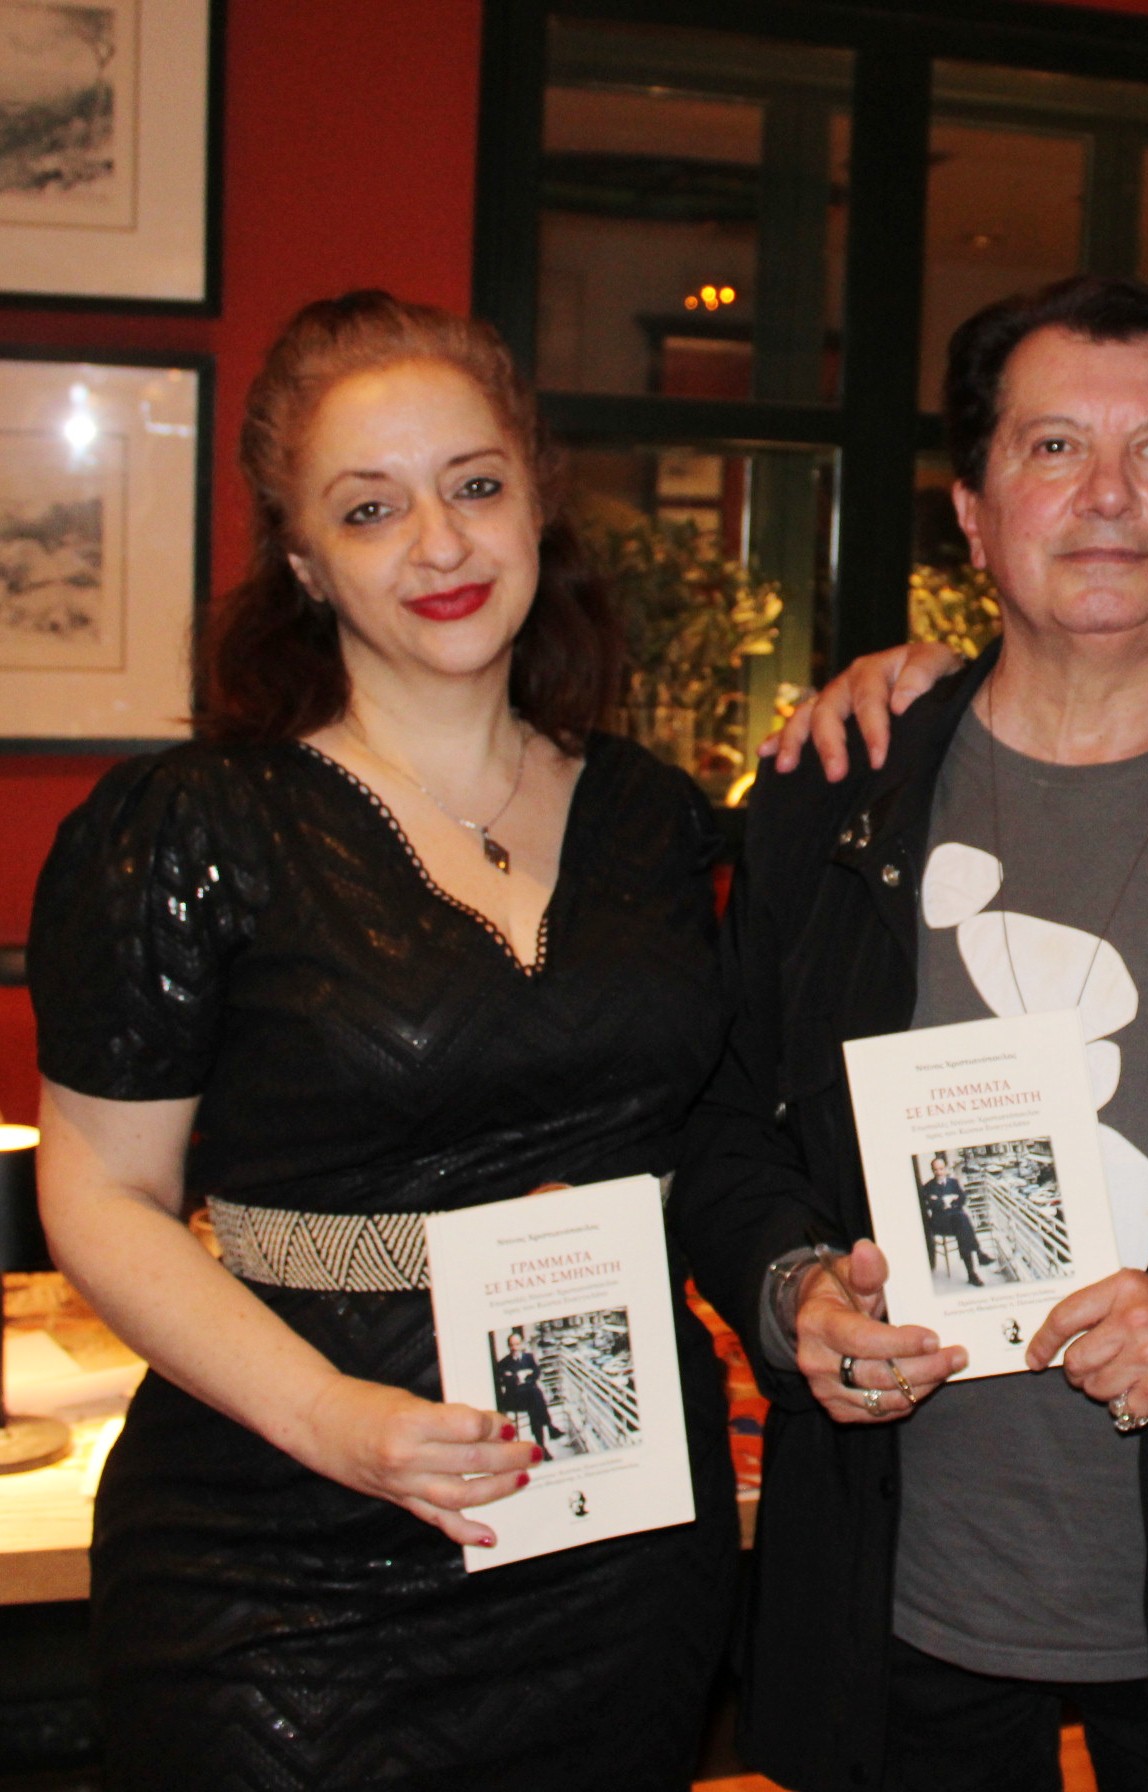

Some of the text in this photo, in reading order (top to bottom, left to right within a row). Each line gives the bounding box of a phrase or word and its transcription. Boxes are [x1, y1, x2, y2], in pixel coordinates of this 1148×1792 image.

[930, 1079, 1012, 1100] ΓΡΑΜΜΑΤΑ
[905, 1090, 1042, 1120] ΣΕ ΕΝΑΝ ΣΜΗΝΙΤΗ
[510, 1250, 593, 1275] ΓΡΑΜΜΑΤΑ
[484, 1282, 501, 1296] ΣΕ
[506, 1275, 547, 1292] ΕΝΑΝ
[550, 1261, 622, 1284] ΣΜΗΝΙΤΗ
